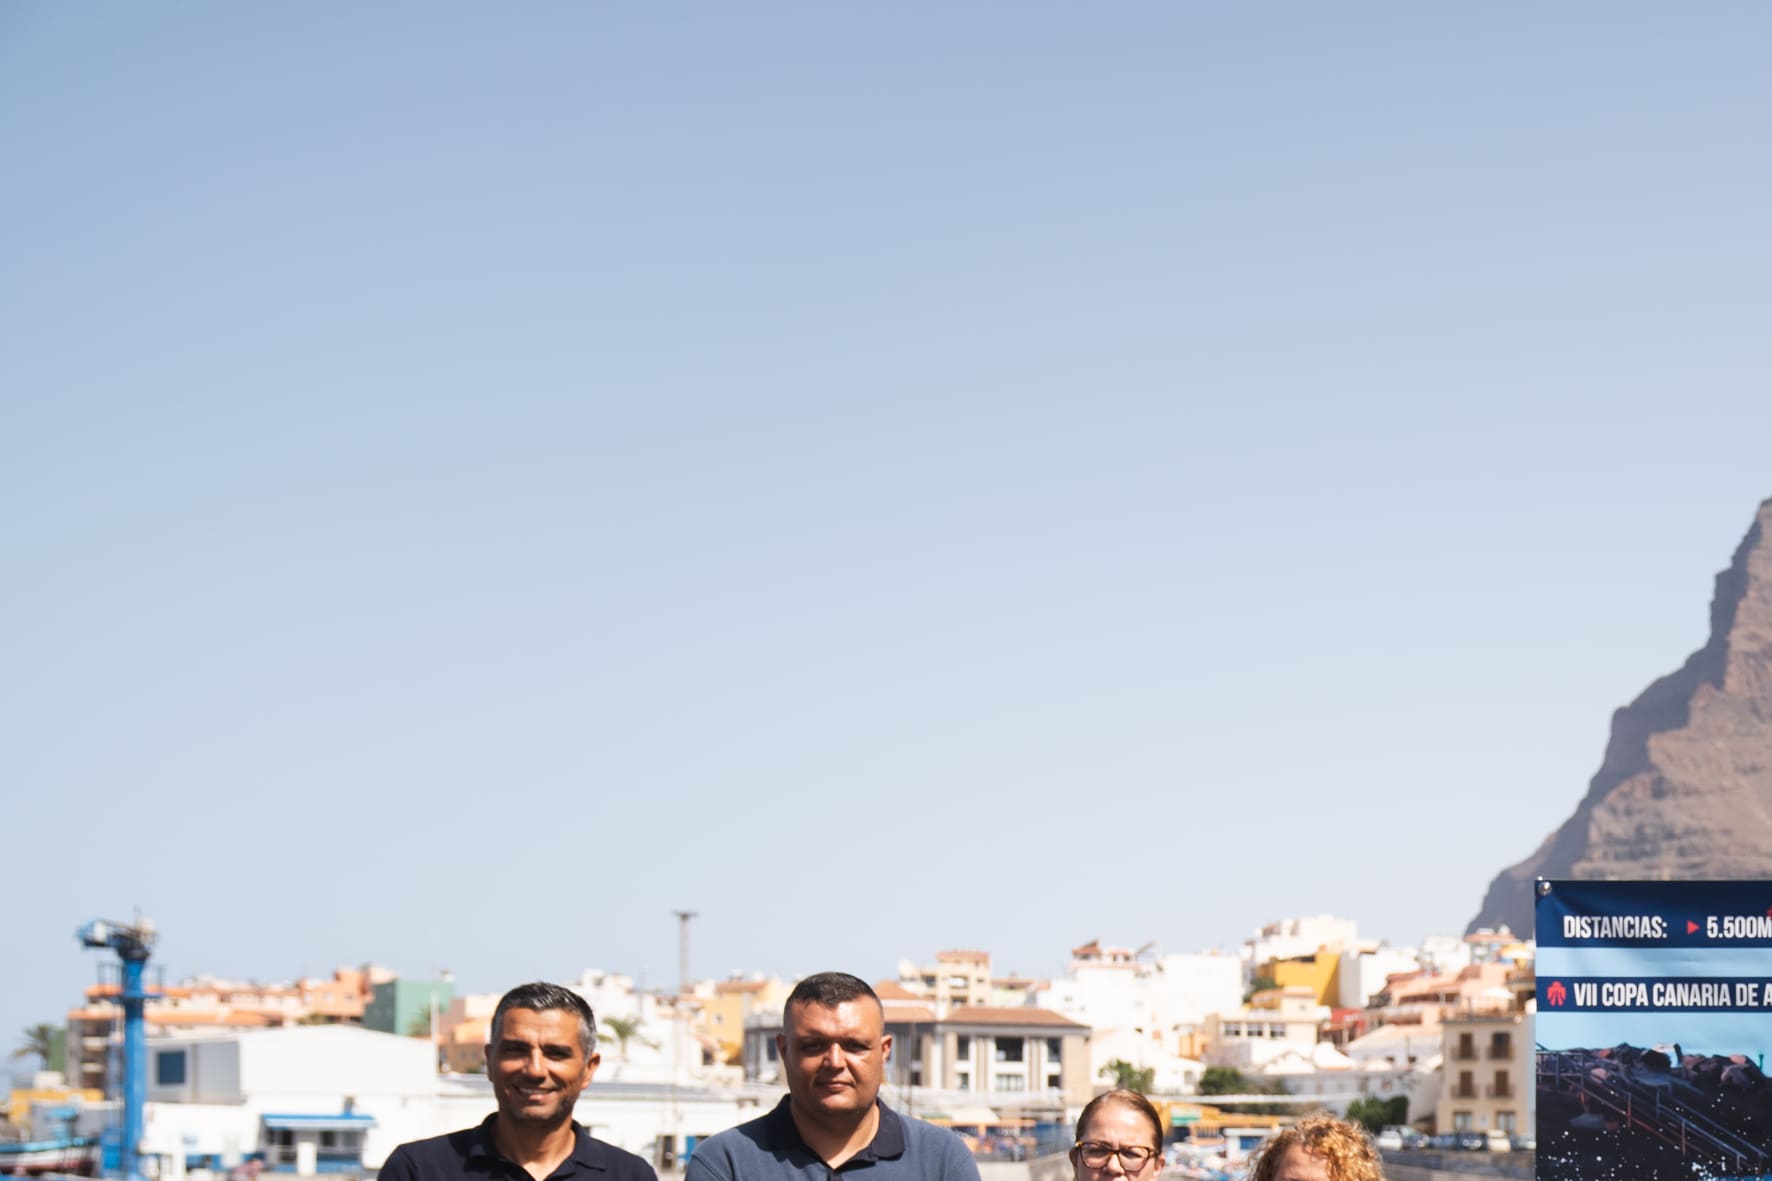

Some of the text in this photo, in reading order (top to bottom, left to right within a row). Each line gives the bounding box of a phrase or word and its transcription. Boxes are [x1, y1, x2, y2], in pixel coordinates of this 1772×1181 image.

[1563, 915, 1668, 939] DISTANCIAS:
[1706, 915, 1772, 939] 5.500M
[1573, 983, 1597, 1007] VII
[1602, 983, 1649, 1007] COPA
[1653, 983, 1732, 1007] CANARIA
[1736, 983, 1758, 1007] DE
